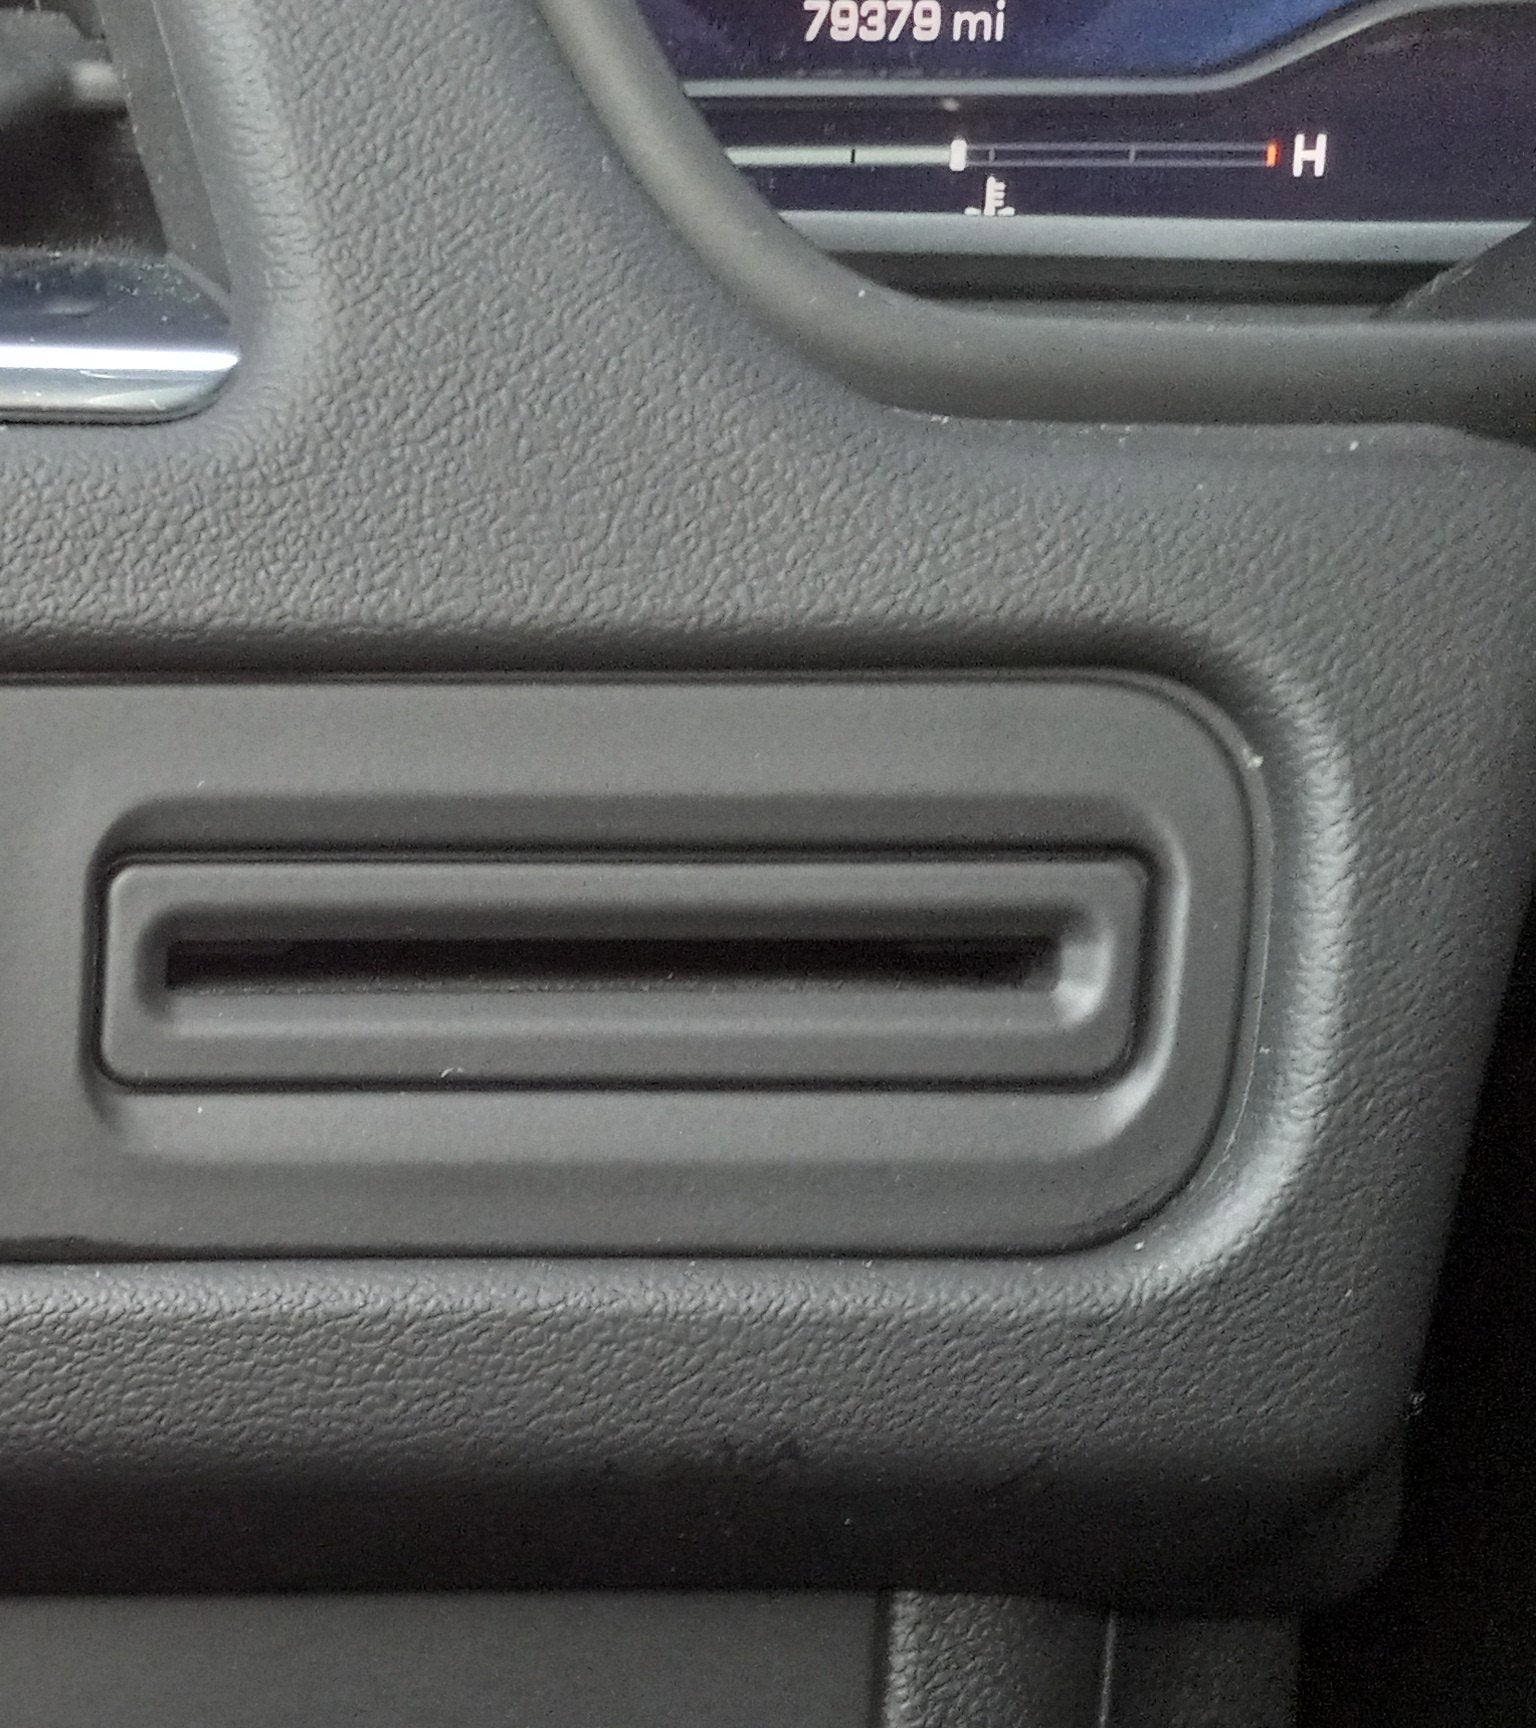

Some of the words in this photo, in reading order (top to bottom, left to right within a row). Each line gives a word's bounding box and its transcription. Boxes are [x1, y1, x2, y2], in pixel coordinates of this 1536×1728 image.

[803, 0, 941, 42] 79379
[952, 0, 1006, 42] mi
[1291, 133, 1327, 177] H
